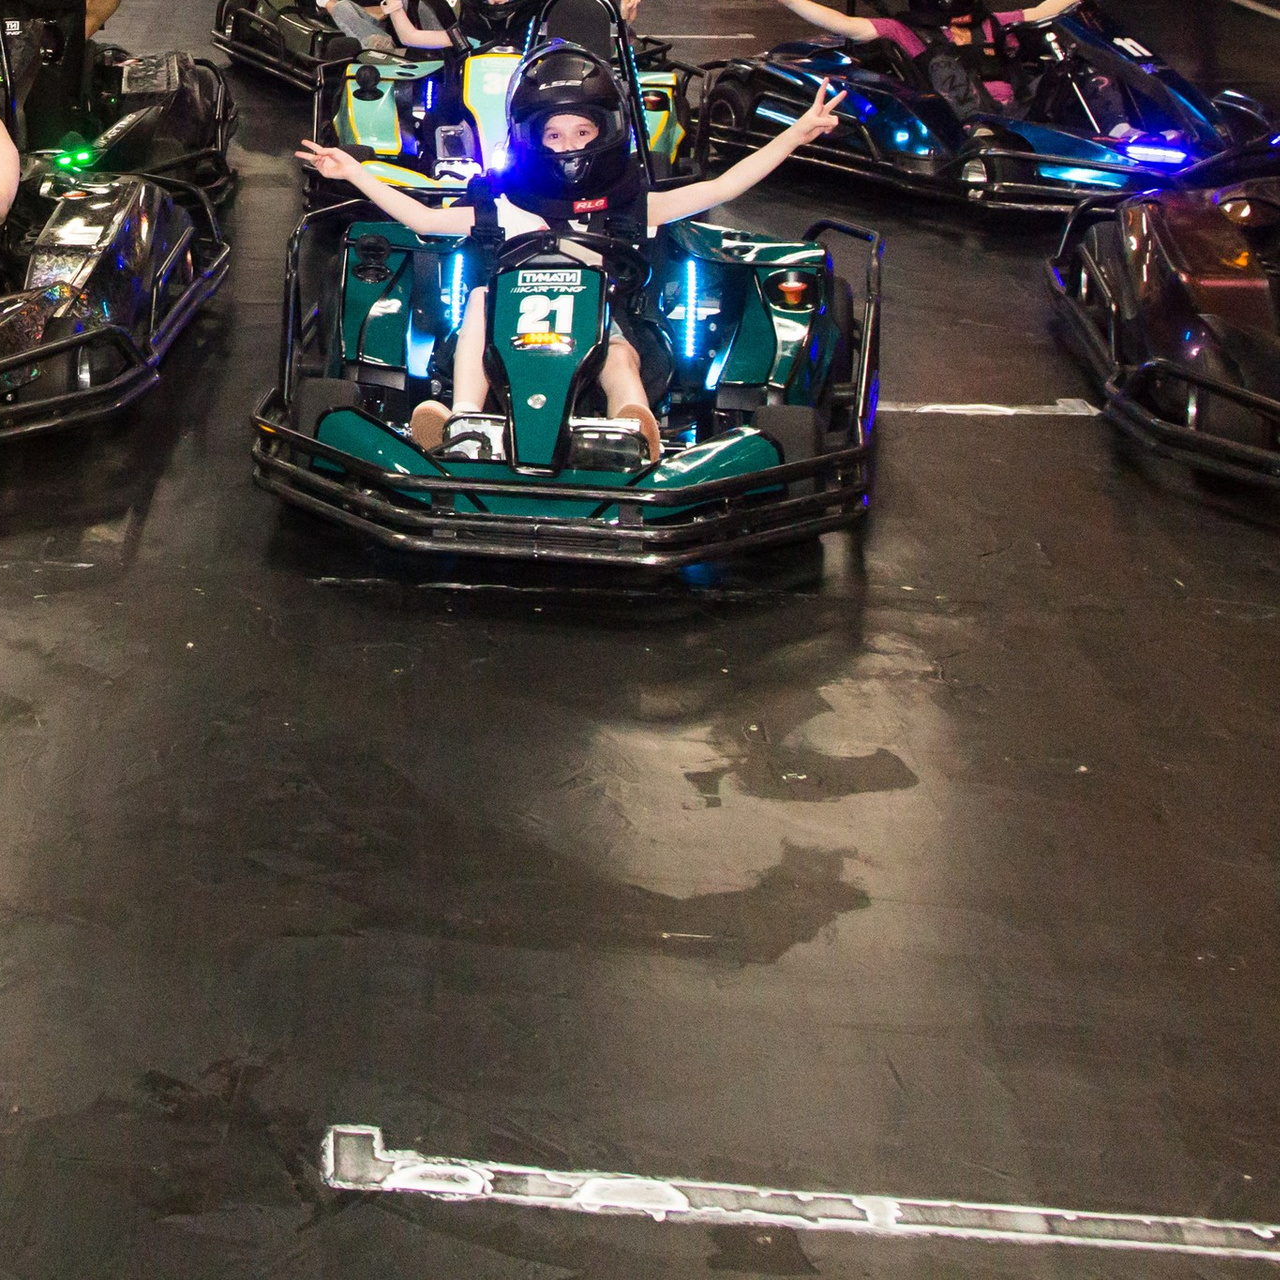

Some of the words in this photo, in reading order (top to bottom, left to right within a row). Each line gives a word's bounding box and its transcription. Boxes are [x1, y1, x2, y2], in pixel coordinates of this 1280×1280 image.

[1113, 38, 1153, 56] 11
[483, 72, 510, 95] 3
[517, 294, 574, 334] 21
